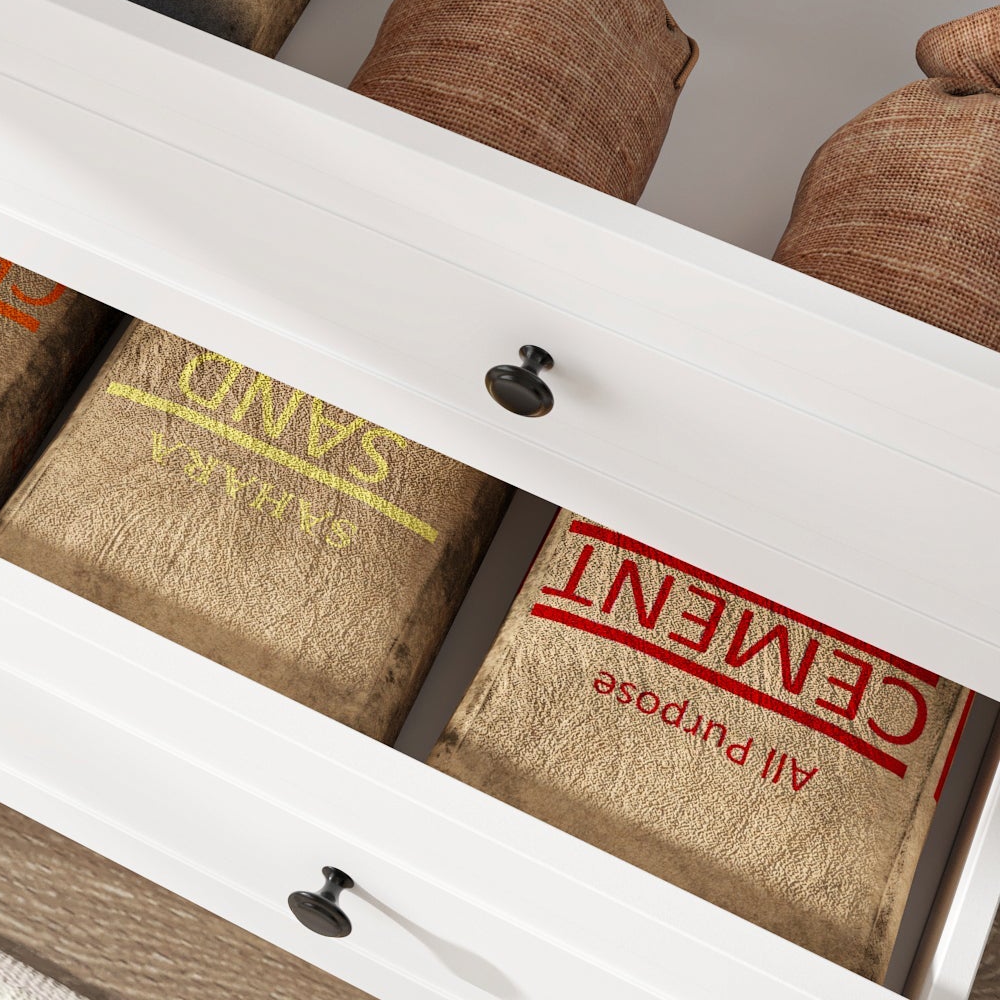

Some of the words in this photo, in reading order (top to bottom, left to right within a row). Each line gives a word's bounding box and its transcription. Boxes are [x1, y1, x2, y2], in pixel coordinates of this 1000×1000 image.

[178, 351, 408, 483] SAND
[150, 430, 358, 549] SAHARA
[541, 543, 928, 746] CEMENT
[593, 671, 753, 766] Purpose
[760, 747, 818, 792] All
